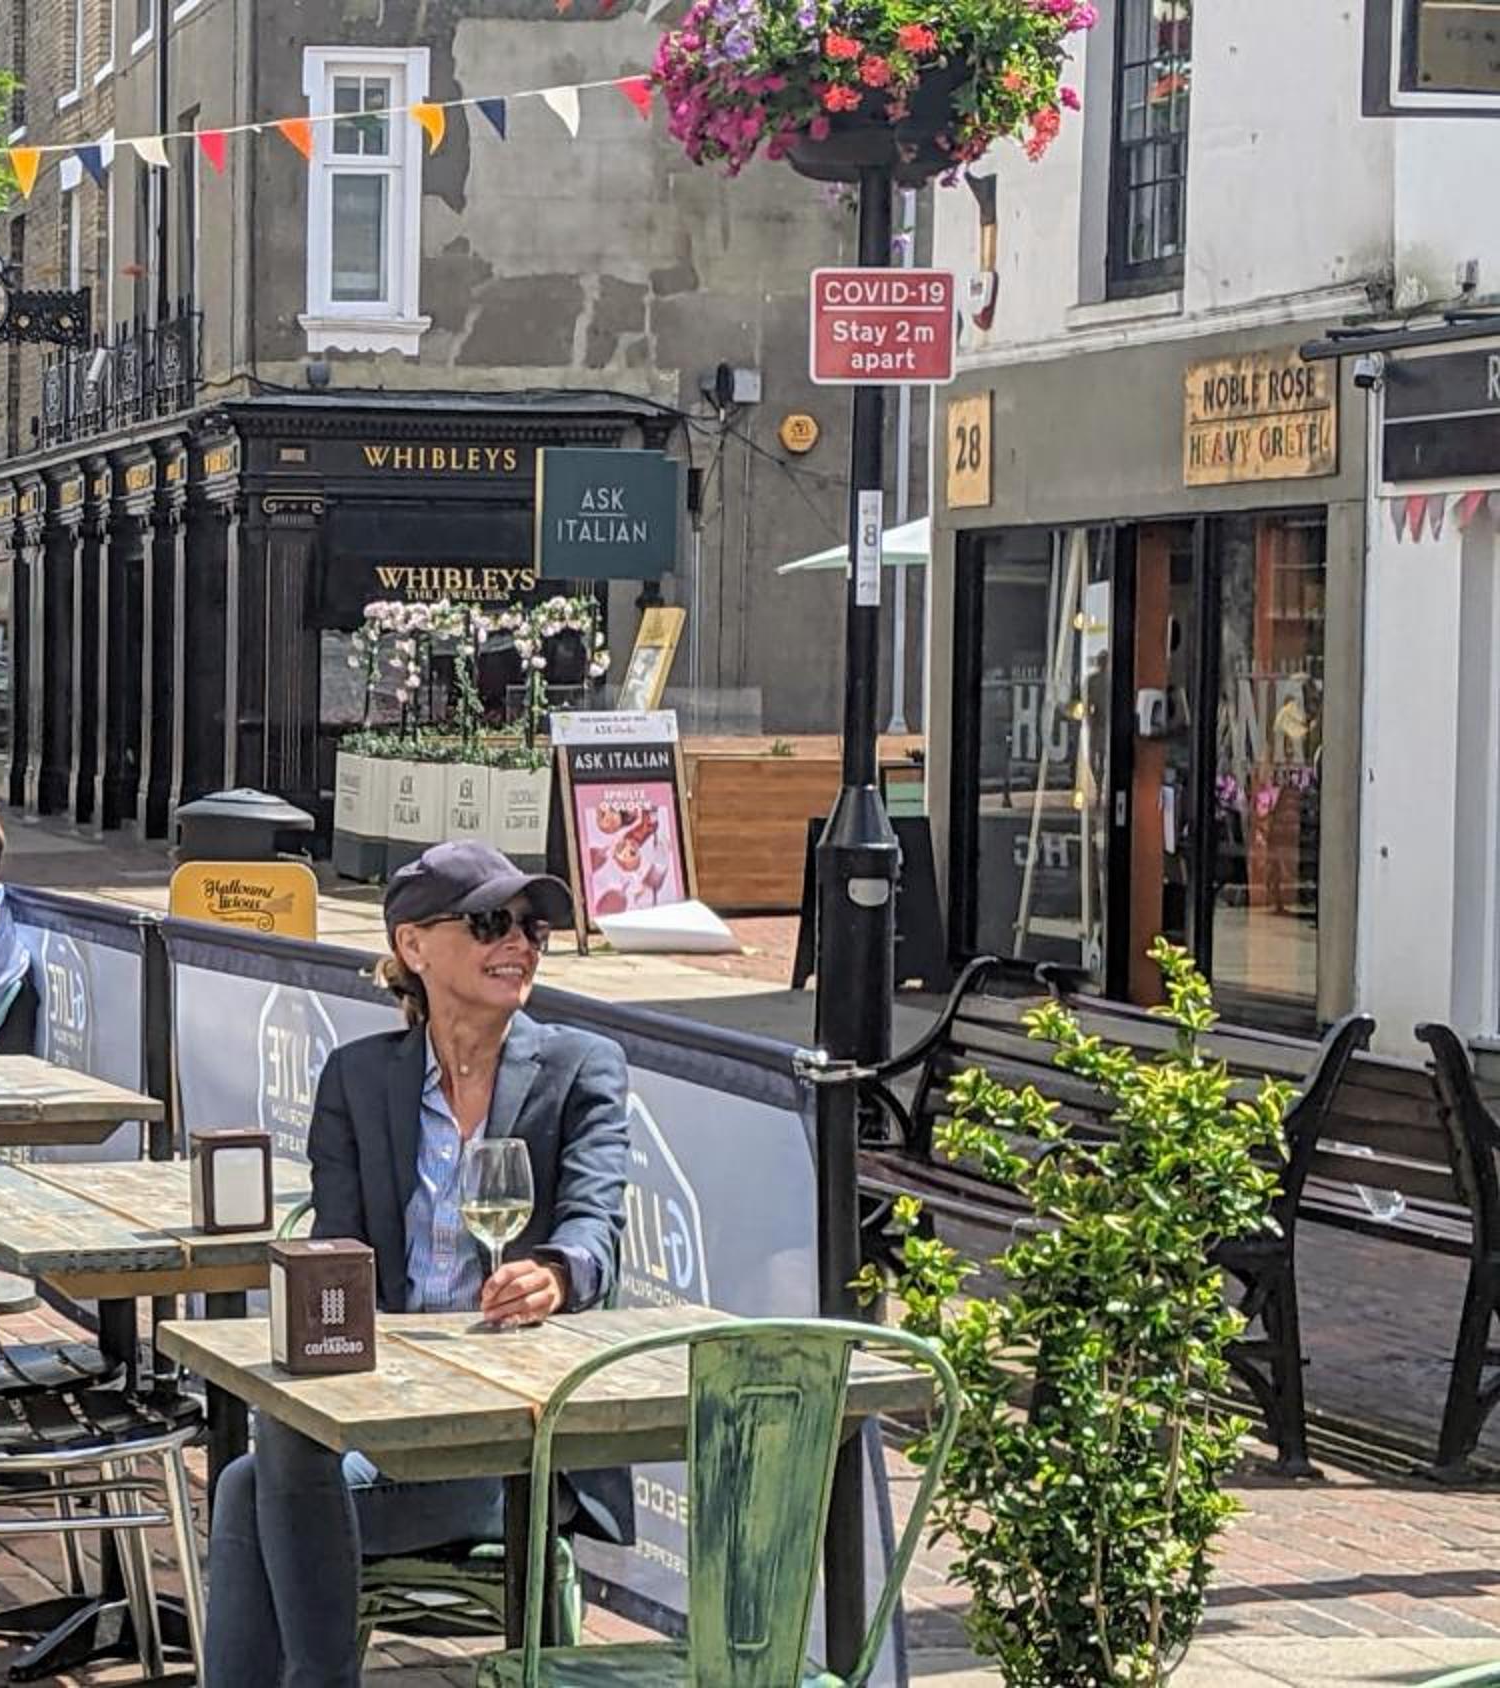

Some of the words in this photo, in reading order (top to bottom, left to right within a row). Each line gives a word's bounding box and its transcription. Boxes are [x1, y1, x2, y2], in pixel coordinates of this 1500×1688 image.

[824, 281, 945, 304] COVID-19
[832, 320, 887, 346] Stay
[851, 348, 916, 372] apart
[1202, 374, 1261, 413] NOBLE
[1268, 367, 1316, 402] ROSE
[955, 424, 982, 472] 28
[1189, 427, 1250, 469] HEAVY
[1258, 413, 1330, 460] GRETEL
[364, 446, 518, 471] WHIBLEYS
[581, 487, 625, 511] ASK
[557, 519, 648, 543] ITALIAN
[375, 566, 536, 591] WHIBLEYS
[575, 752, 603, 769] ASK
[607, 752, 669, 769] ITALIAN
